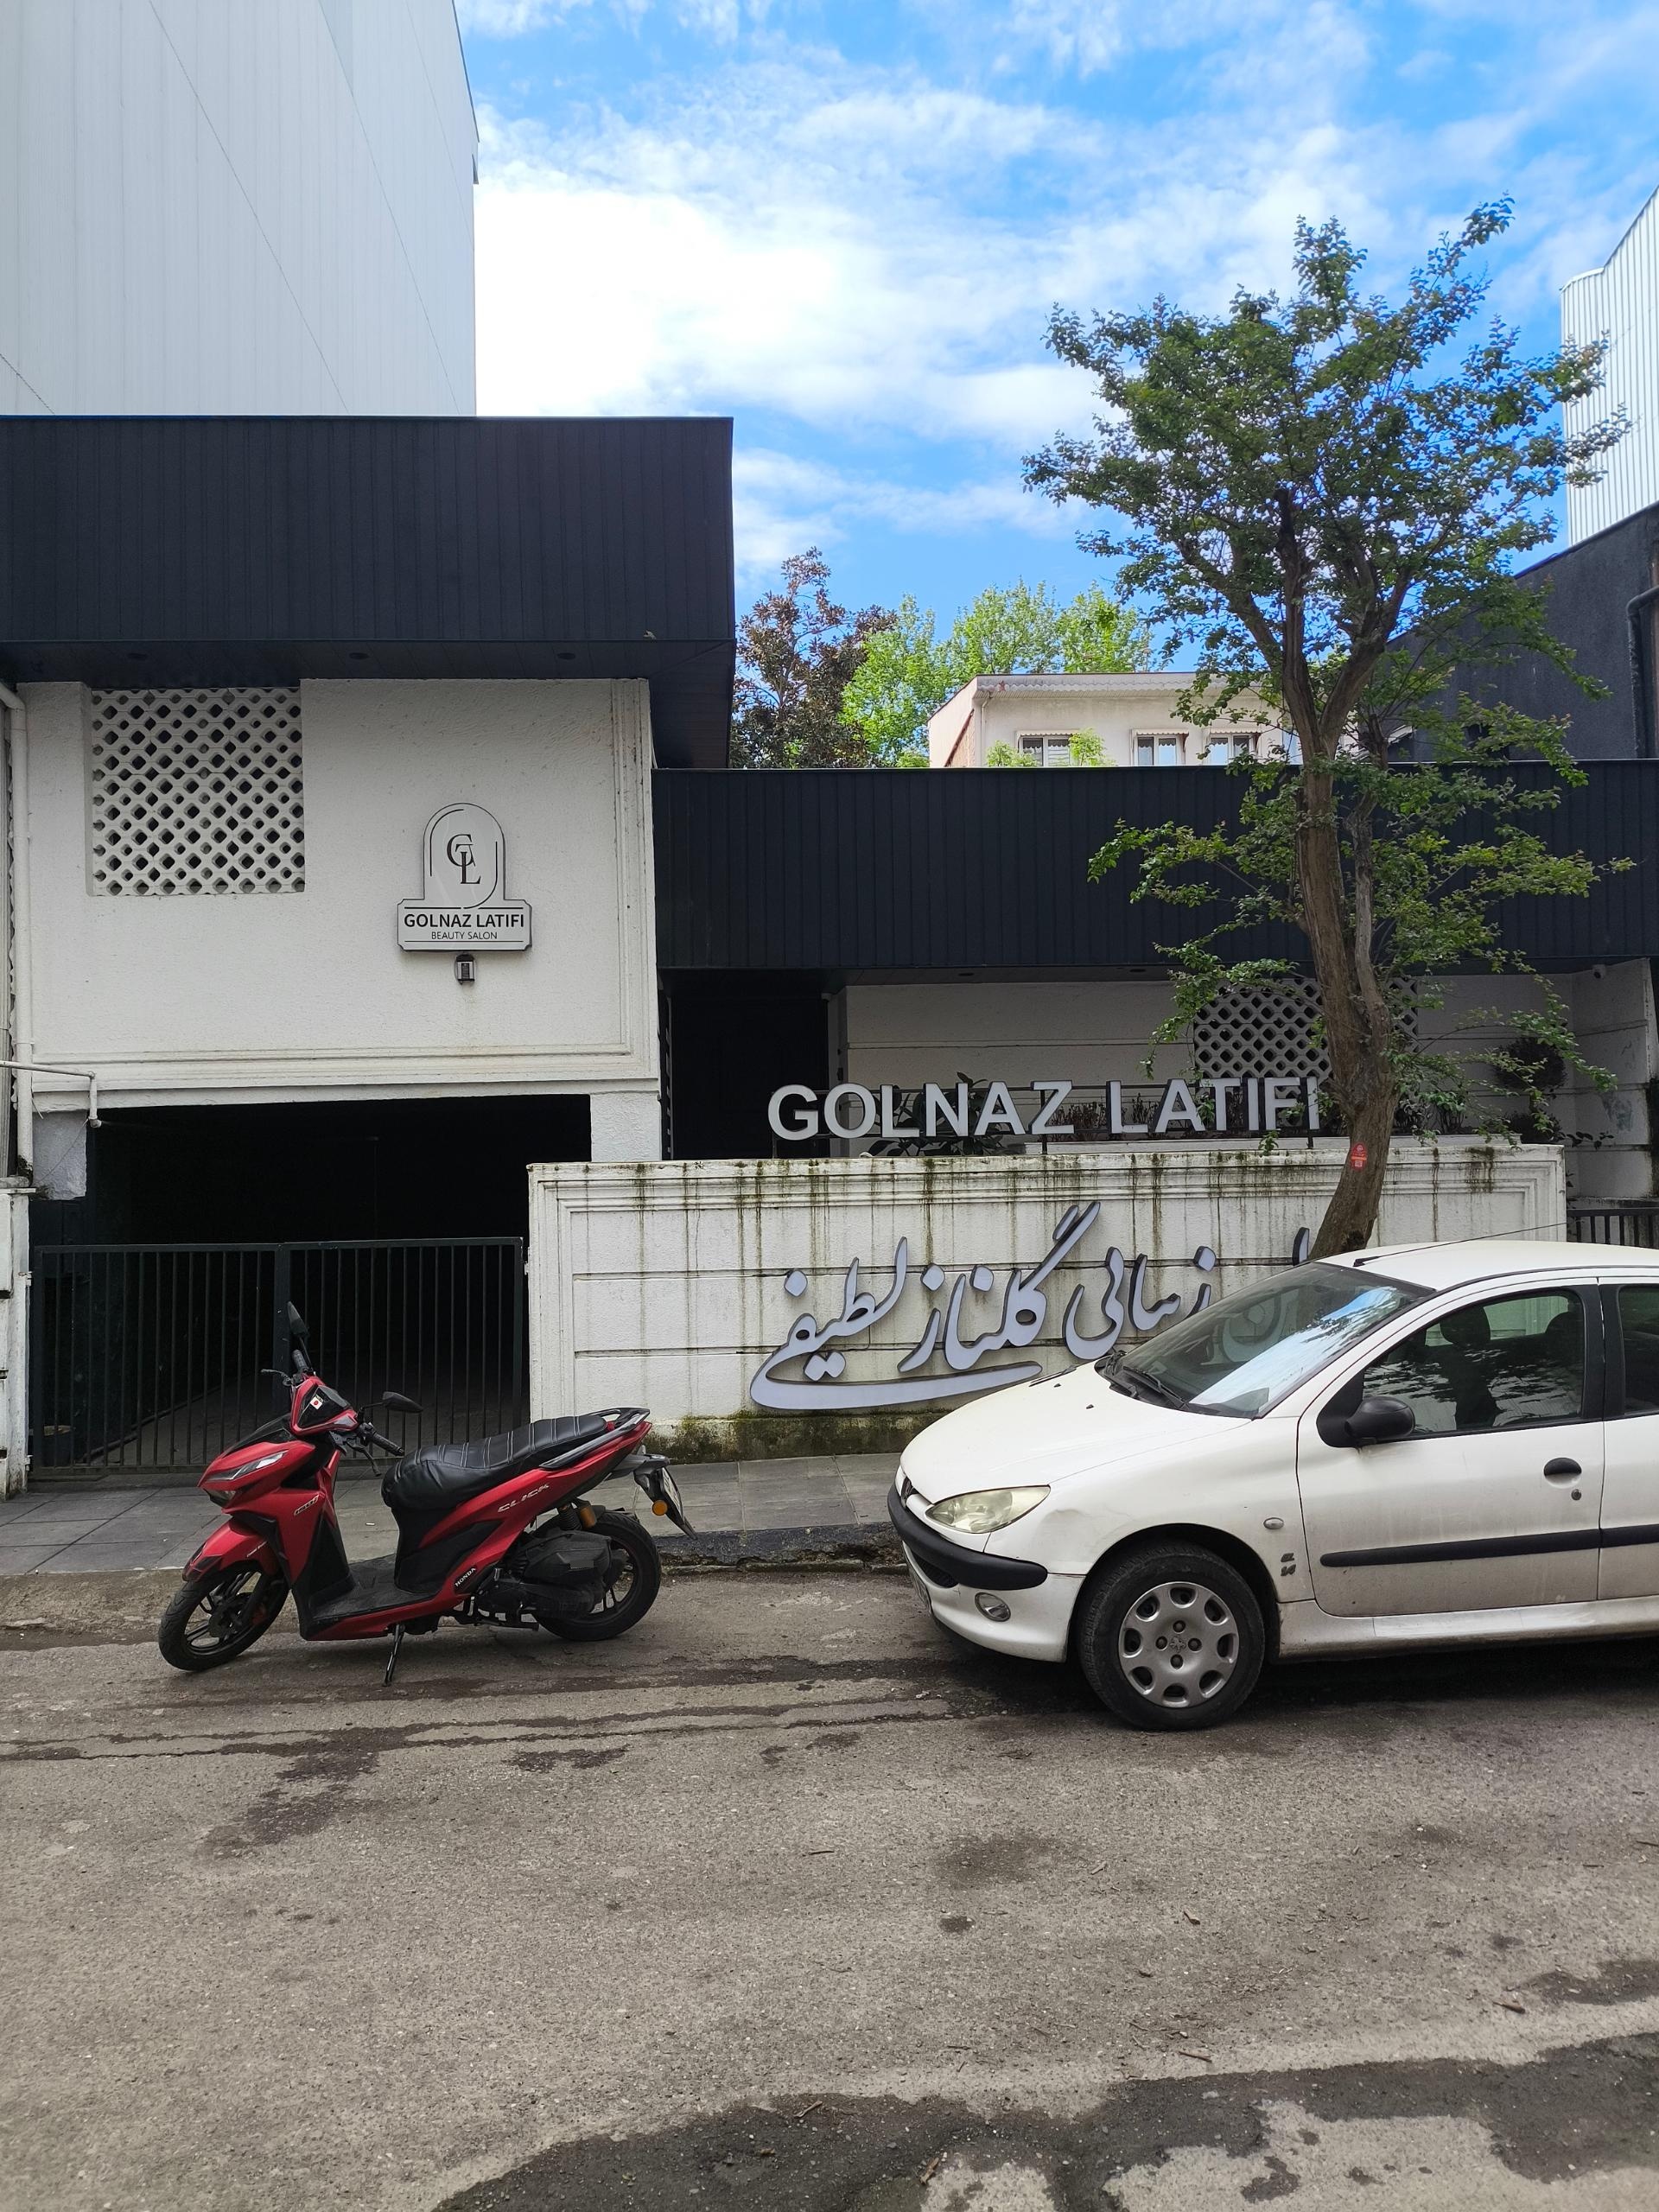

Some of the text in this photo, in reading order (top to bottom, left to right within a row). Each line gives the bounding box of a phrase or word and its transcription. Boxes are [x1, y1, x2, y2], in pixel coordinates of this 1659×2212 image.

[404, 914, 524, 927] GOLNAZ LATIFI
[766, 1076, 1321, 1141] GOLNAZ LATIFI
[896, 1201, 1102, 1373] گلناز
[749, 1236, 1043, 1410] لطیفی
[498, 1483, 550, 1513] CLICK
[454, 1567, 476, 1587] HONDA
